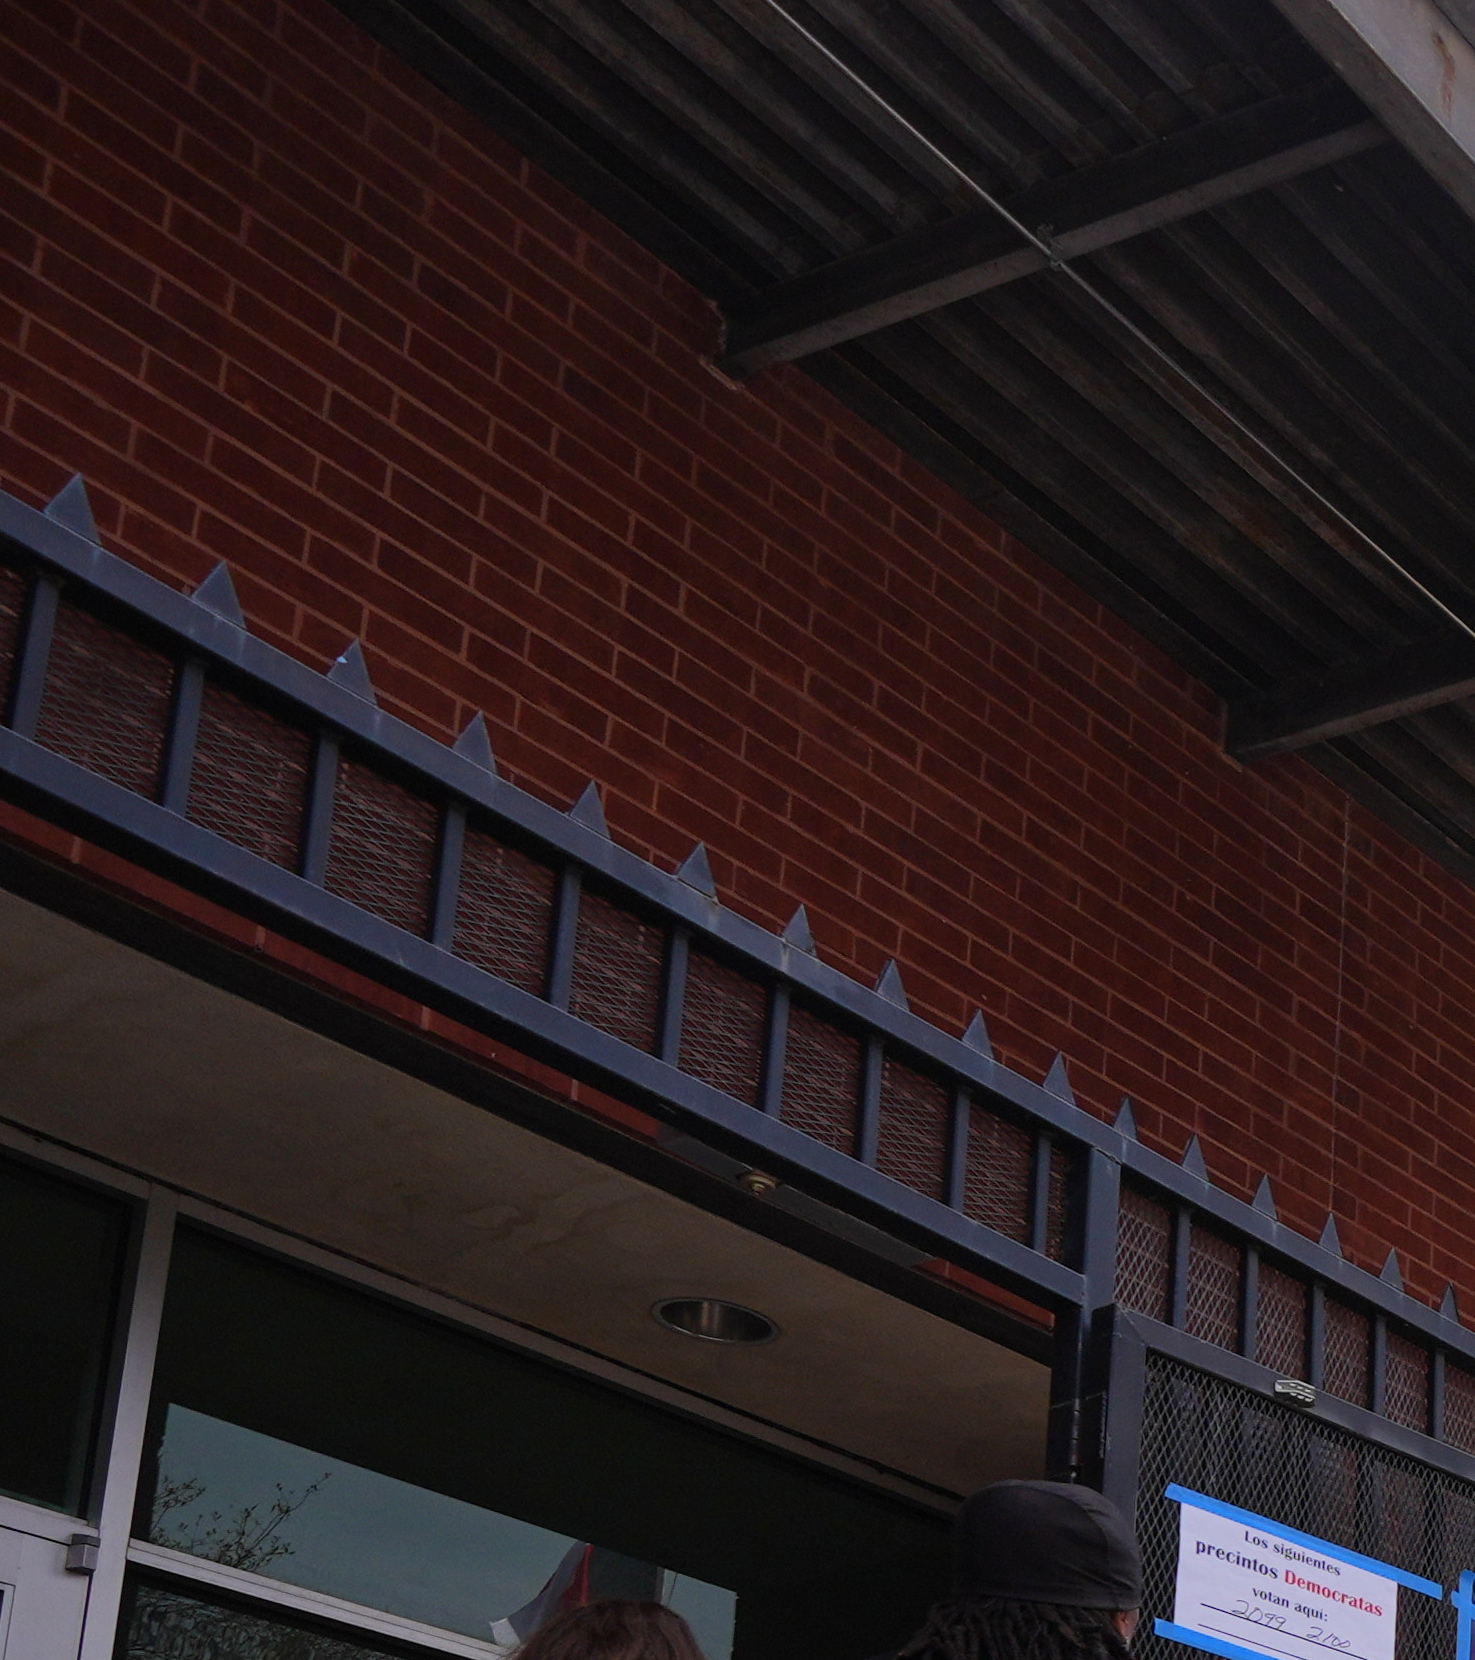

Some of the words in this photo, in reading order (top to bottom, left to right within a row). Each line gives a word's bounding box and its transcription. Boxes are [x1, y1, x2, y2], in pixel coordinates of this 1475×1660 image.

[1245, 1530, 1268, 1549] Los
[1273, 1542, 1341, 1576] siguientes
[1195, 1539, 1279, 1580] precintos
[1284, 1569, 1384, 1617] Democratas
[1231, 1599, 1287, 1630] 2099
[1306, 1626, 1351, 1649] 2100
[1252, 1587, 1290, 1609] votan
[1294, 1602, 1329, 1622] aquí:
